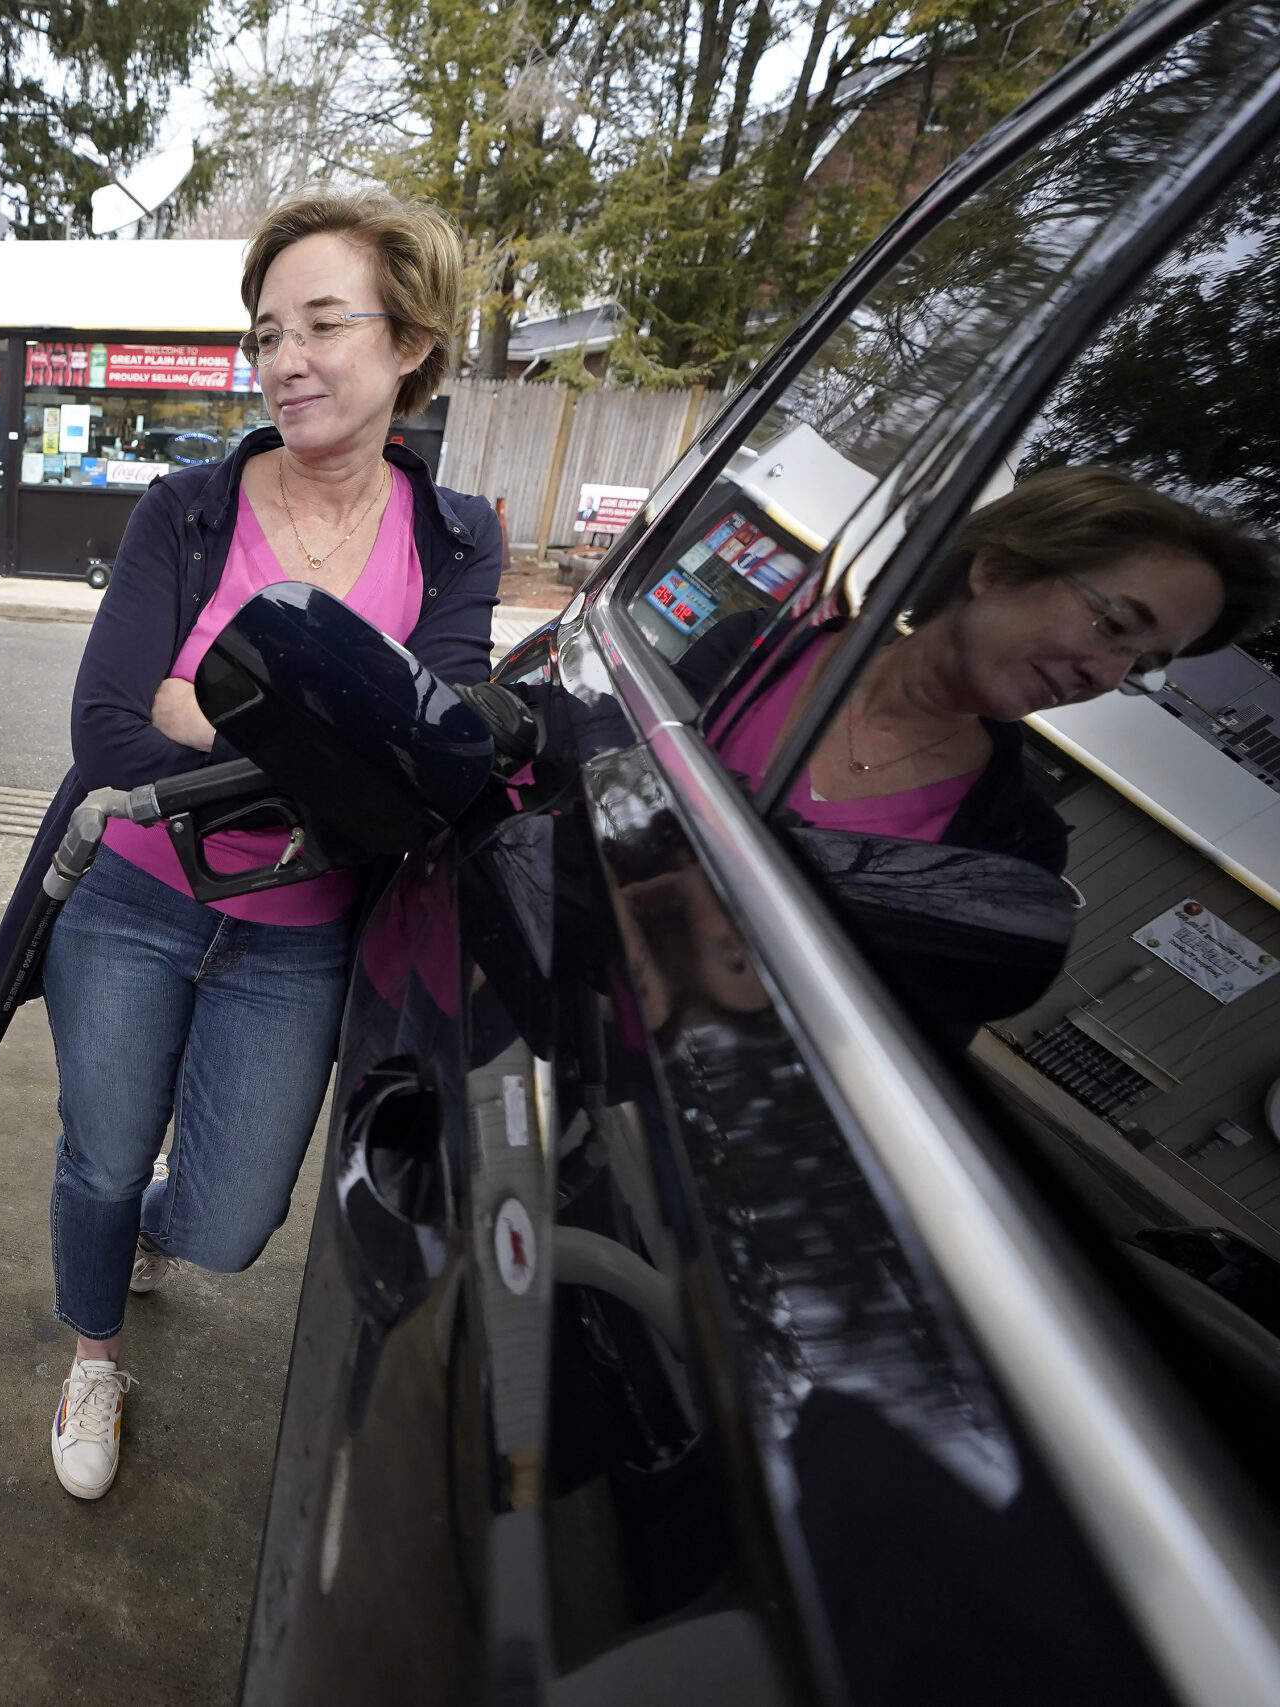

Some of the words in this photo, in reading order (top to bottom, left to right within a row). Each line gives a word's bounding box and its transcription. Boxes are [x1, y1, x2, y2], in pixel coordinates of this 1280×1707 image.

[144, 346, 184, 354] WELCOME
[187, 347, 198, 355] TO
[110, 355, 143, 365] GREAT
[144, 356, 175, 366] PLAIN
[176, 356, 196, 366] AVE
[198, 356, 230, 367] MOBIL
[109, 372, 150, 382] PROUDLY
[151, 373, 188, 383] SELLING
